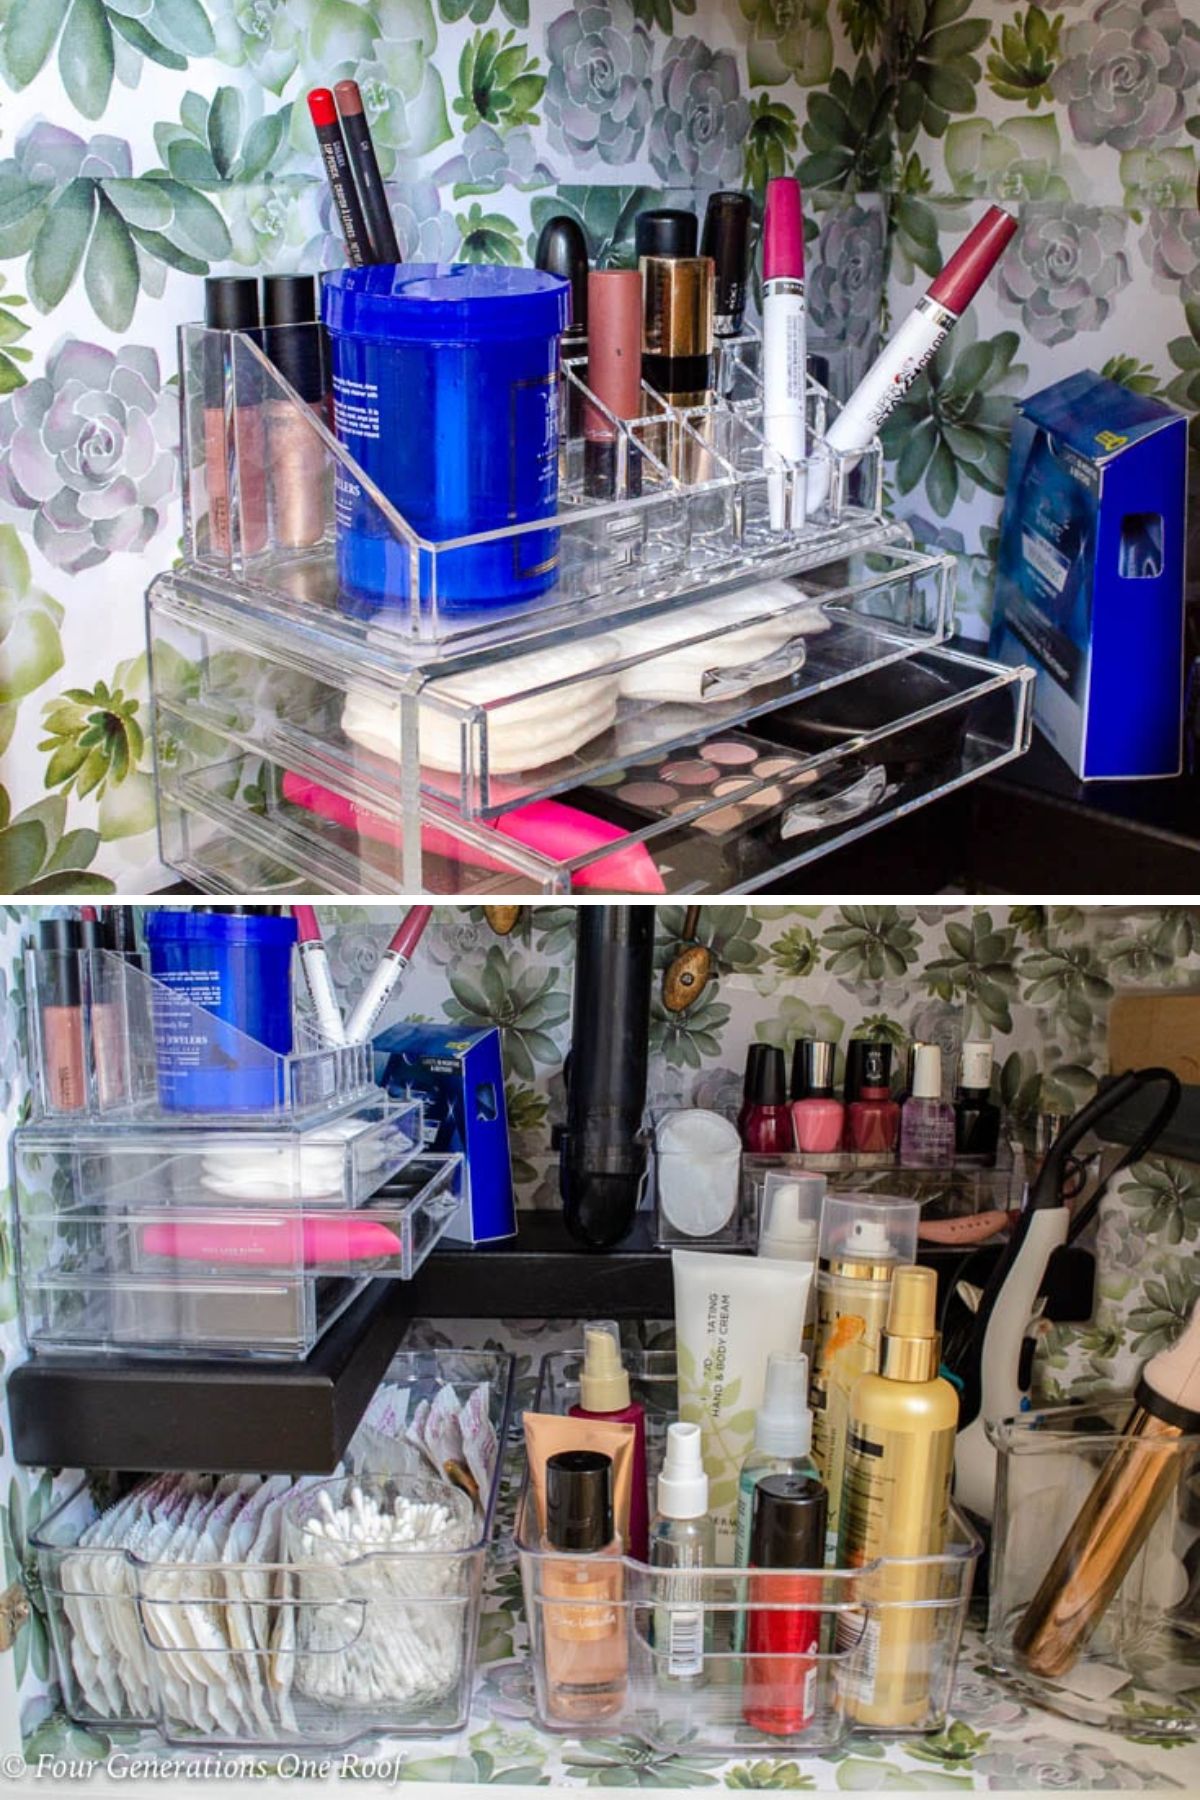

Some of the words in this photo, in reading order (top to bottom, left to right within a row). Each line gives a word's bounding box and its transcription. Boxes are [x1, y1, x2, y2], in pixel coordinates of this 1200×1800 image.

[719, 1295, 730, 1334] CREAM
[716, 1339, 726, 1370] BODY
[712, 1385, 722, 1417] HAND
